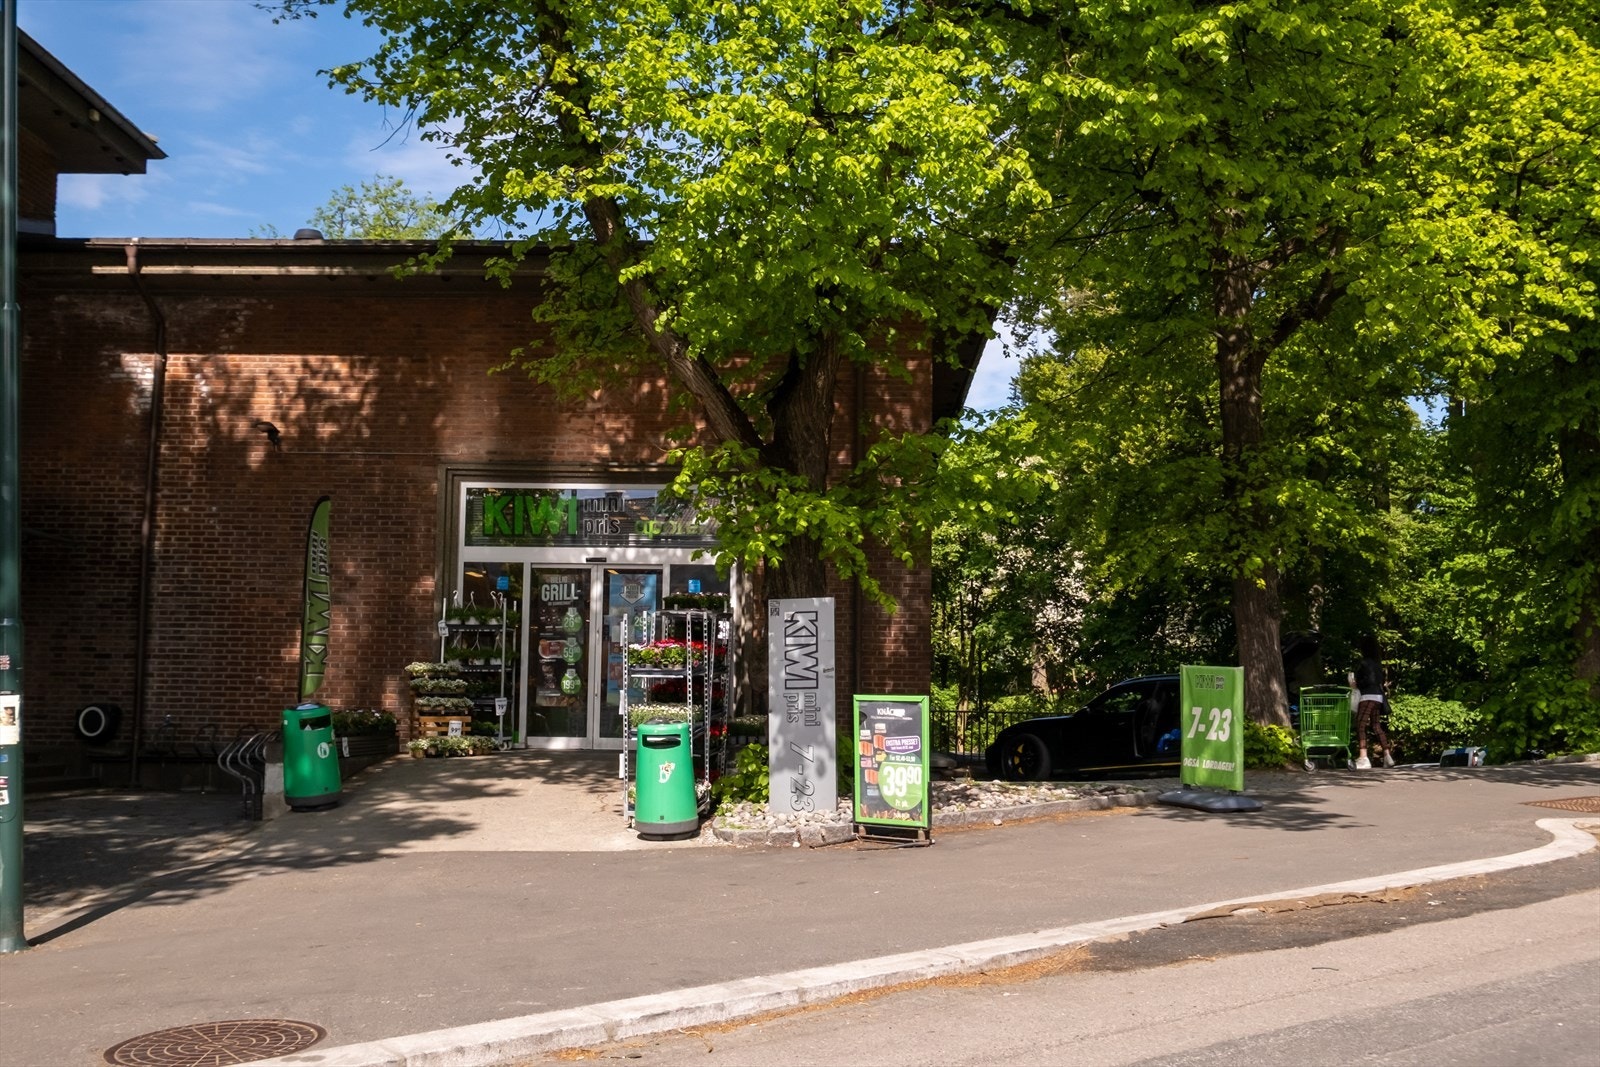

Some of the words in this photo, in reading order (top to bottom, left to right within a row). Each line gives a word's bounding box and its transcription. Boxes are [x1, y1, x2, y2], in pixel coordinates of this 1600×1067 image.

[483, 495, 577, 535] KIWI
[583, 492, 625, 513] mini
[583, 513, 621, 538] pris
[318, 537, 330, 577] pris
[305, 576, 331, 677] KIWI
[784, 611, 819, 689] KIWI
[783, 692, 799, 723] pris
[804, 692, 821, 727] mini
[1187, 706, 1232, 742] 7-23
[1183, 756, 1199, 767] OGSÅ
